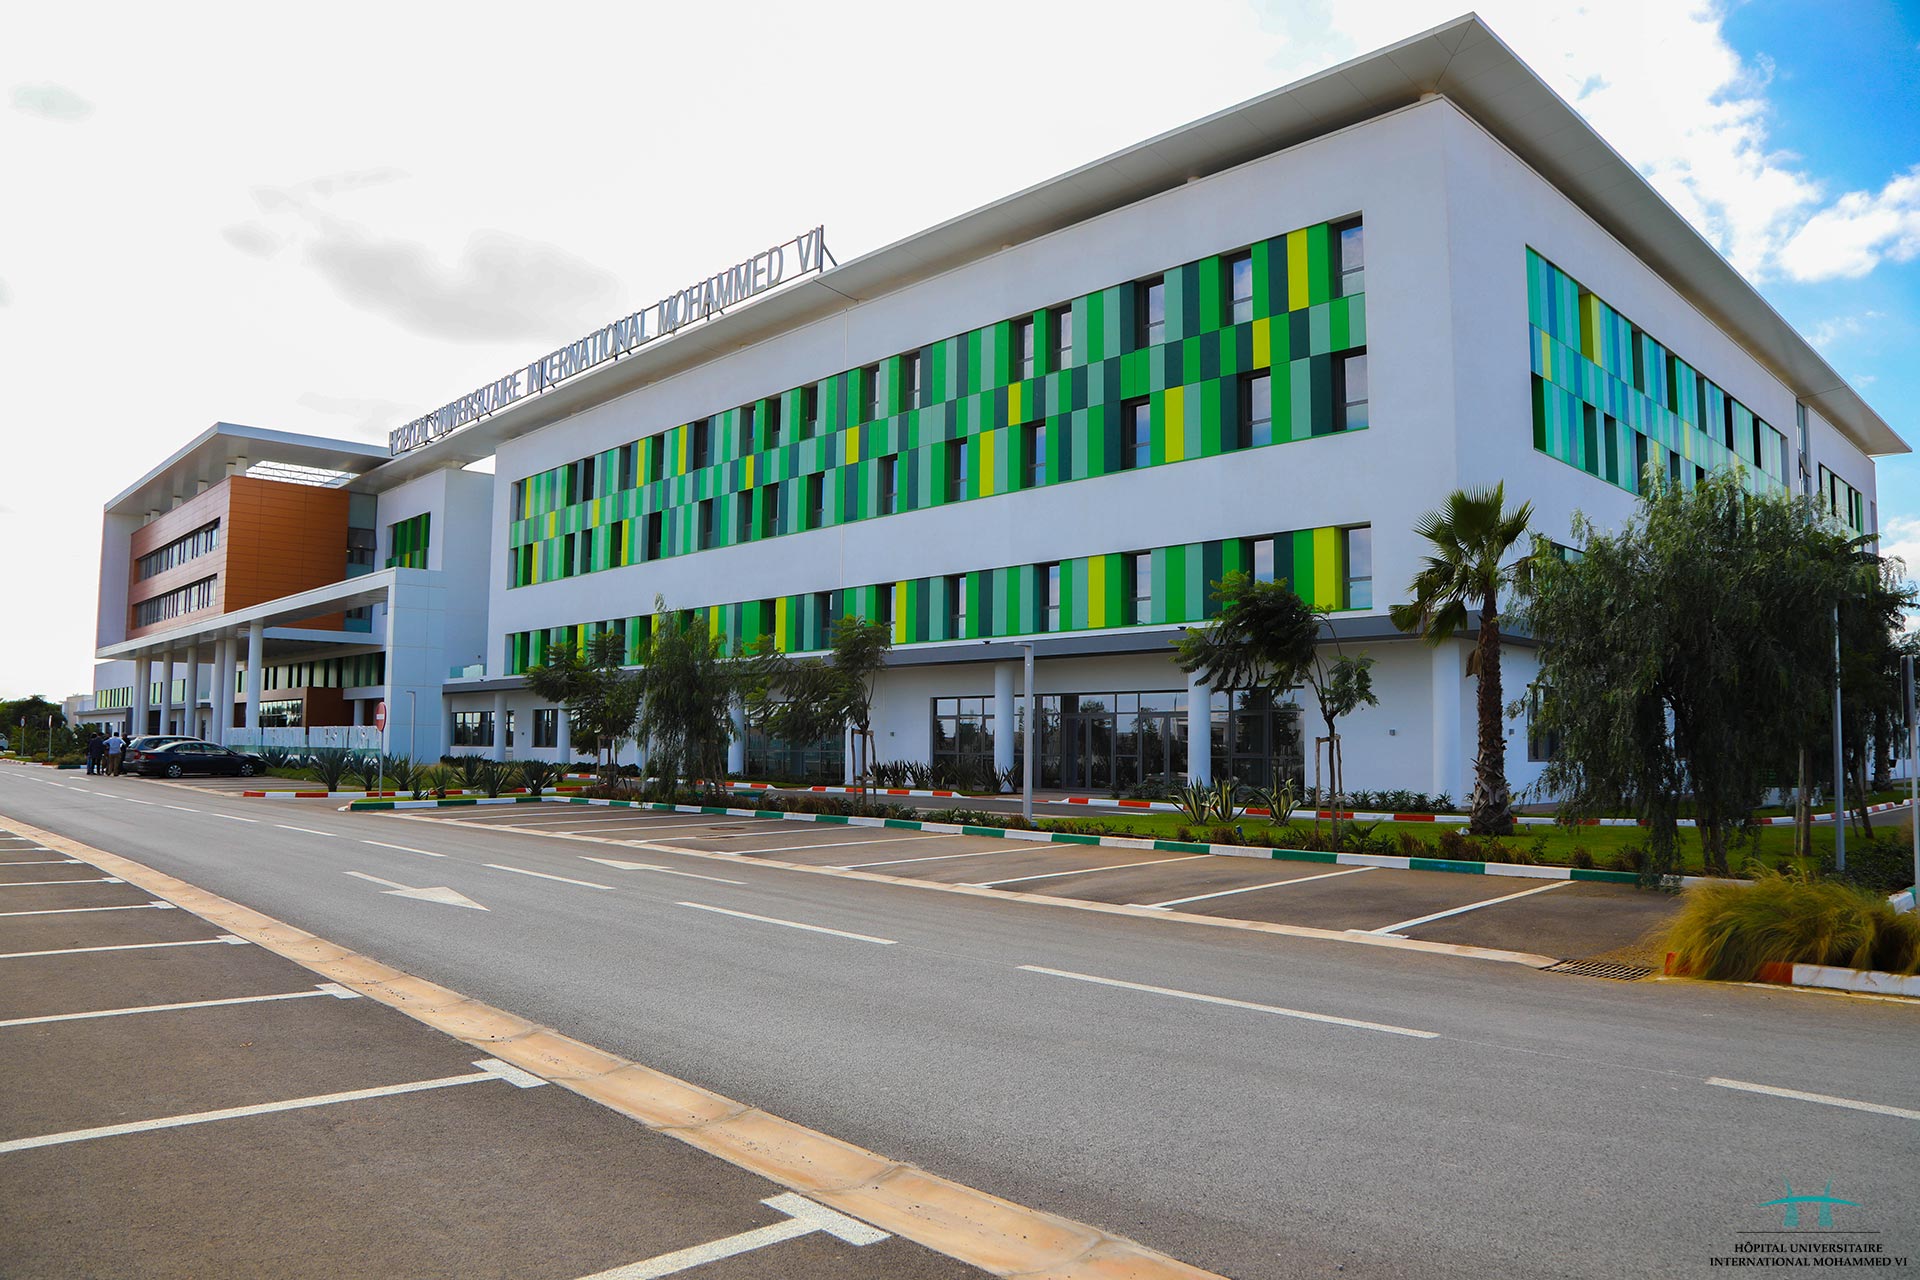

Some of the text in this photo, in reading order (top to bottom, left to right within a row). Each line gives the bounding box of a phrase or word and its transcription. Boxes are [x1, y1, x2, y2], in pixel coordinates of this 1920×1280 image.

[433, 369, 521, 436] UNIVERSITAIRE
[527, 308, 650, 395] INTERNATIONAL
[657, 246, 784, 336] MOHAMMED
[796, 226, 820, 274] VI
